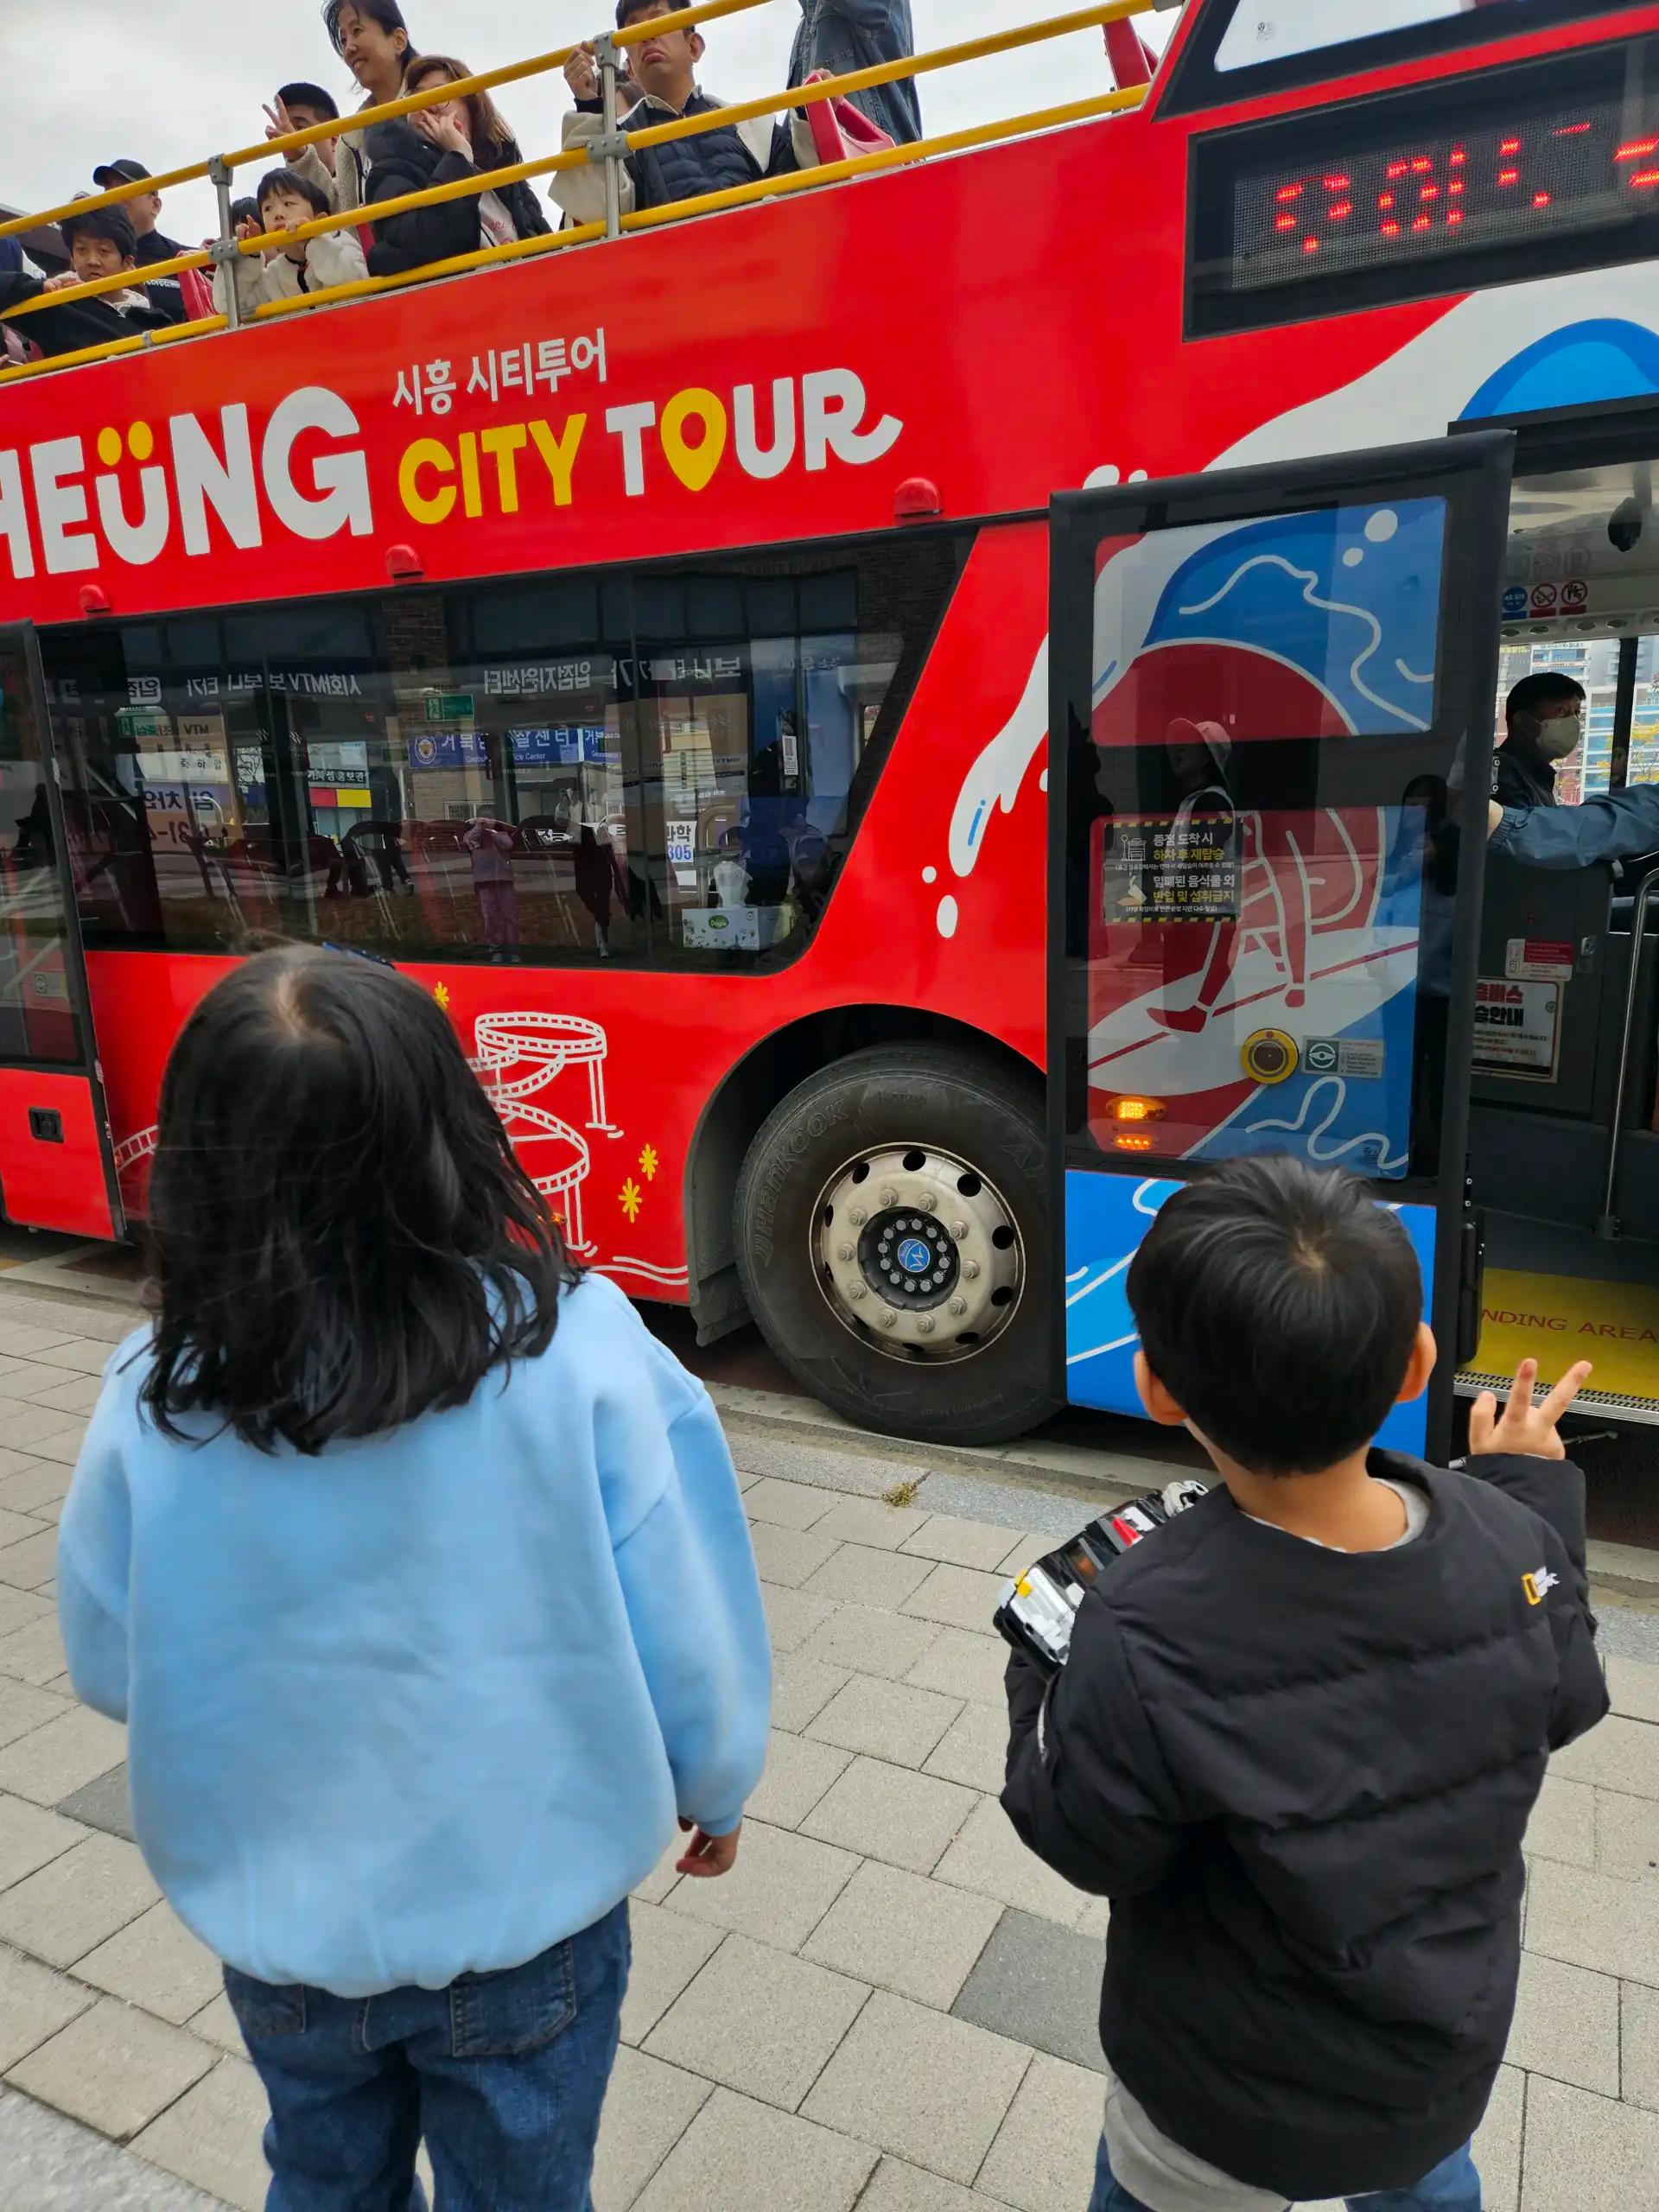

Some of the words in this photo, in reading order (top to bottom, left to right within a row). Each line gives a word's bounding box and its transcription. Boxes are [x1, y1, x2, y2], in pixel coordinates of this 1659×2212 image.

[393, 359, 455, 415] 시흥
[467, 327, 607, 401] 시티투어
[398, 413, 587, 524] CITY
[606, 367, 903, 497] TOUR
[1179, 833, 1200, 846] 도착
[1202, 831, 1213, 845] 시
[1153, 849, 1176, 861] 하차
[1178, 849, 1188, 861] 후
[1191, 848, 1225, 861] 재탑승
[1187, 874, 1222, 887] 음식물
[1223, 874, 1236, 887] 외
[1153, 890, 1175, 903] 반입
[1177, 890, 1188, 903] 및
[1190, 889, 1235, 902] 섭취금지
[1578, 1322, 1658, 1343] AREA
